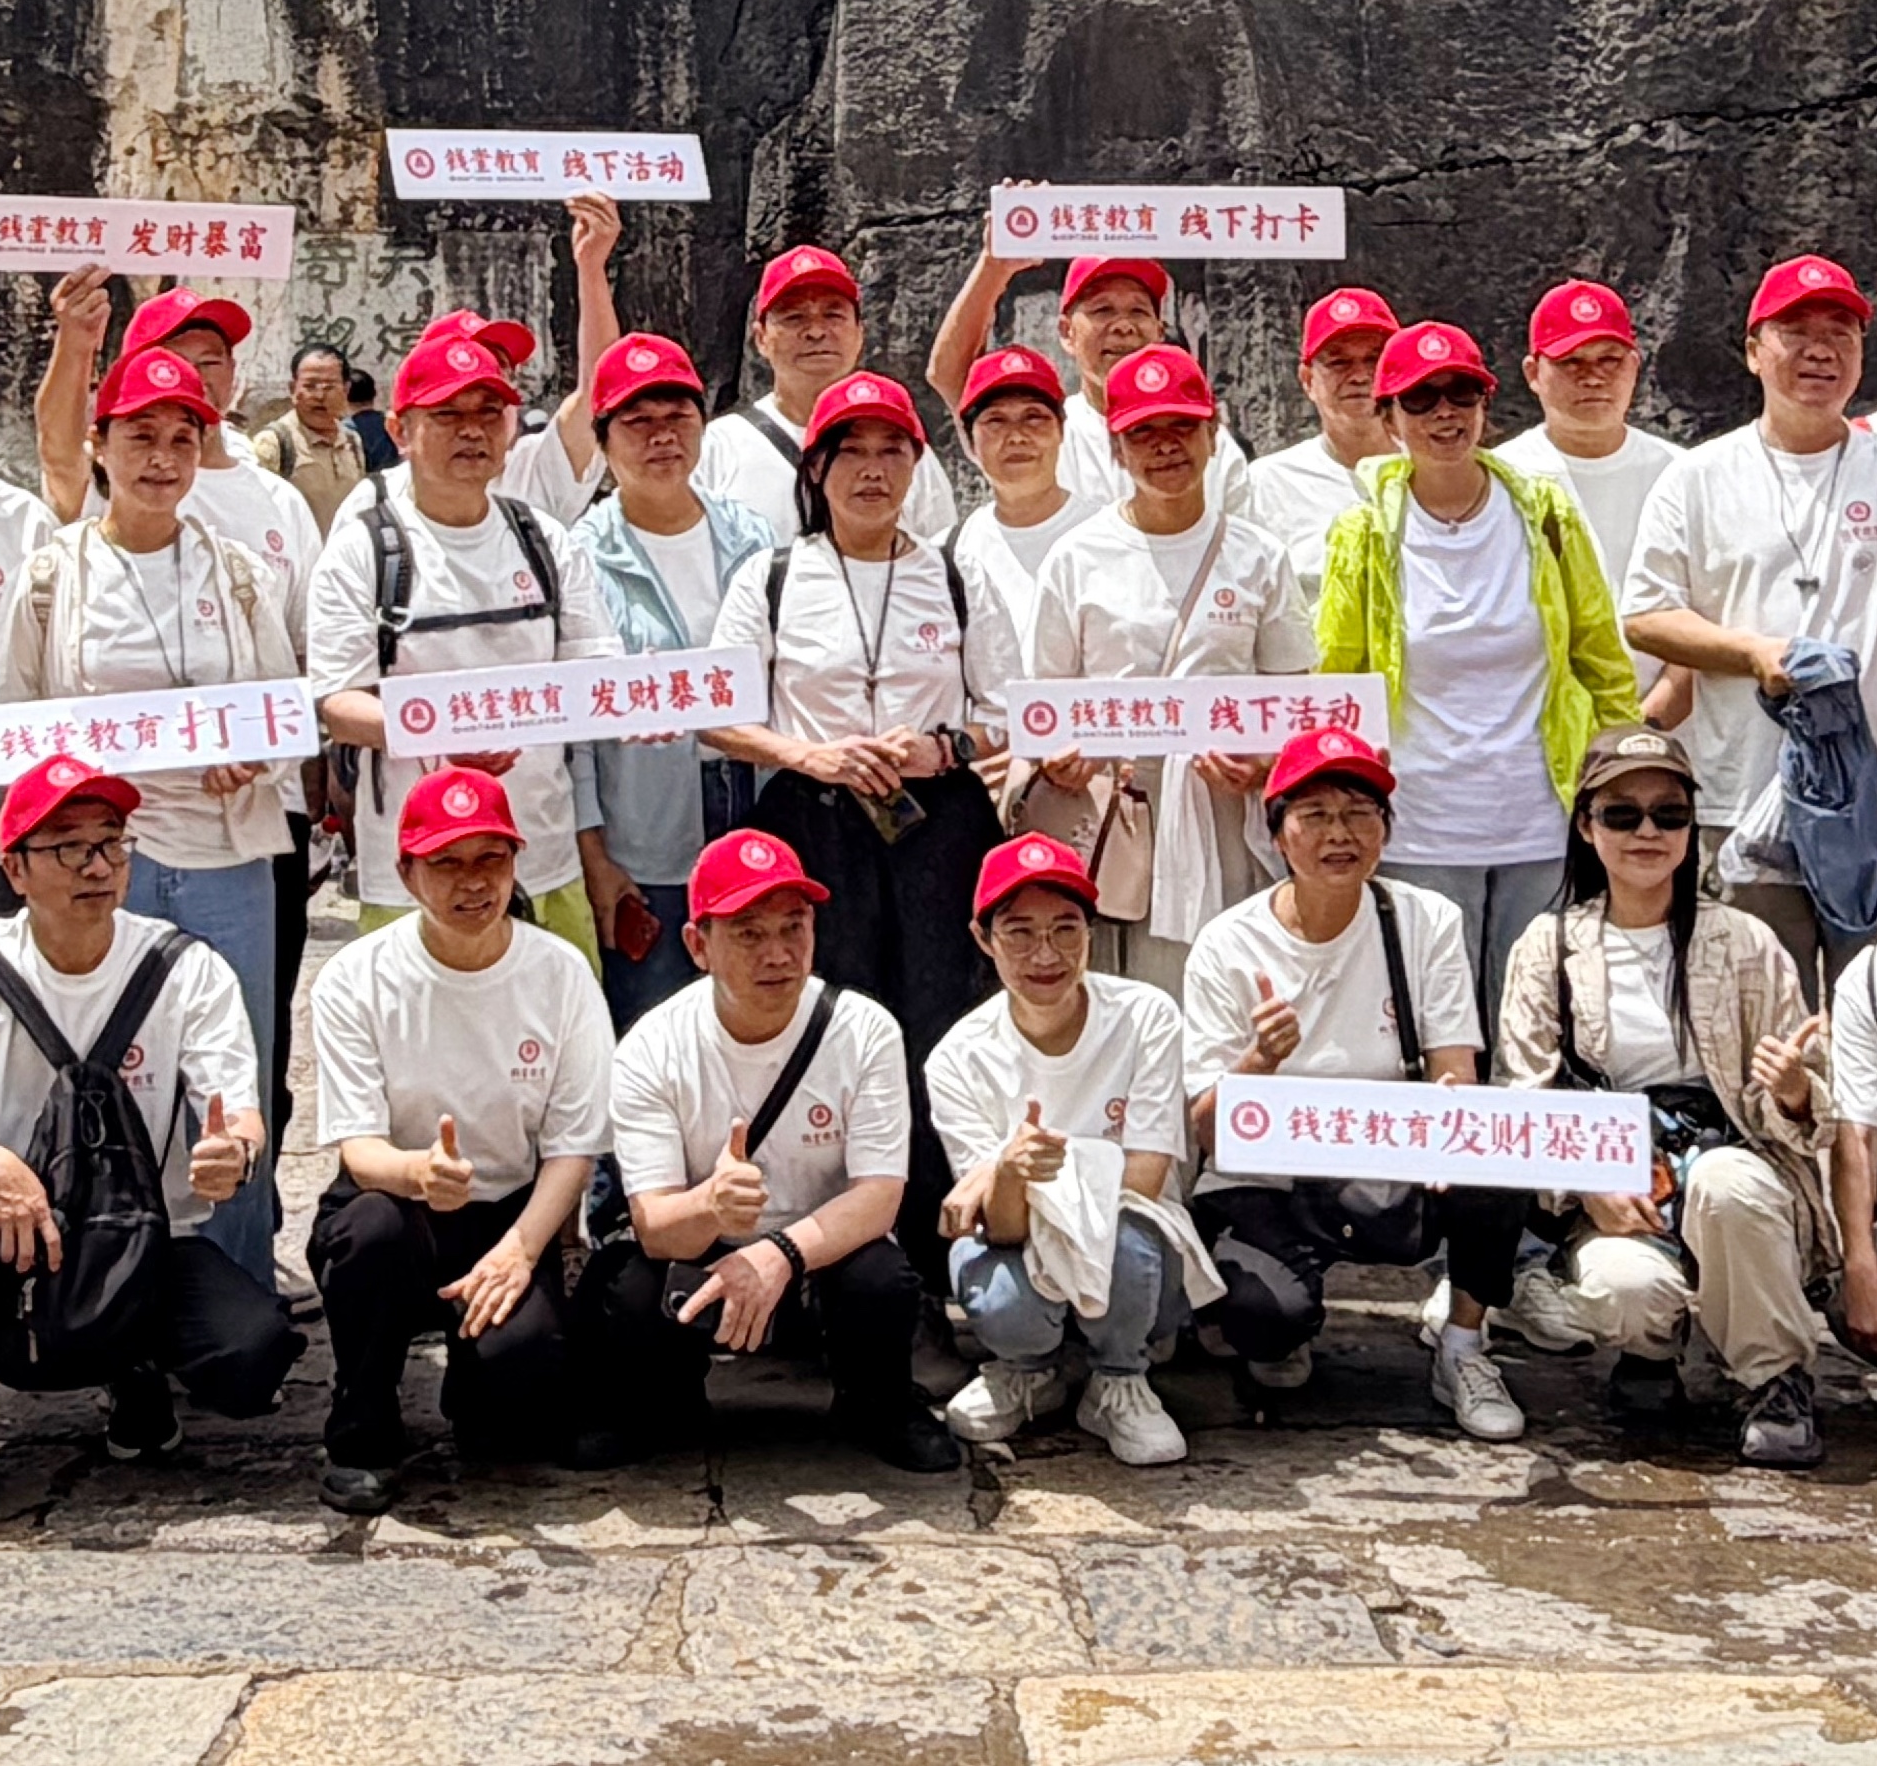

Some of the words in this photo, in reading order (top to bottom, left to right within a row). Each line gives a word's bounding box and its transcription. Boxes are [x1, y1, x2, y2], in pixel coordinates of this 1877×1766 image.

[561, 148, 685, 183] 线下活动
[126, 218, 268, 261] 发财暴富
[1179, 202, 1321, 242] 线下打卡
[589, 665, 735, 719] 发财暴富
[1209, 692, 1363, 734] 线下活动
[177, 692, 304, 752] 打卡
[1439, 1107, 1640, 1165] 发财暴富
